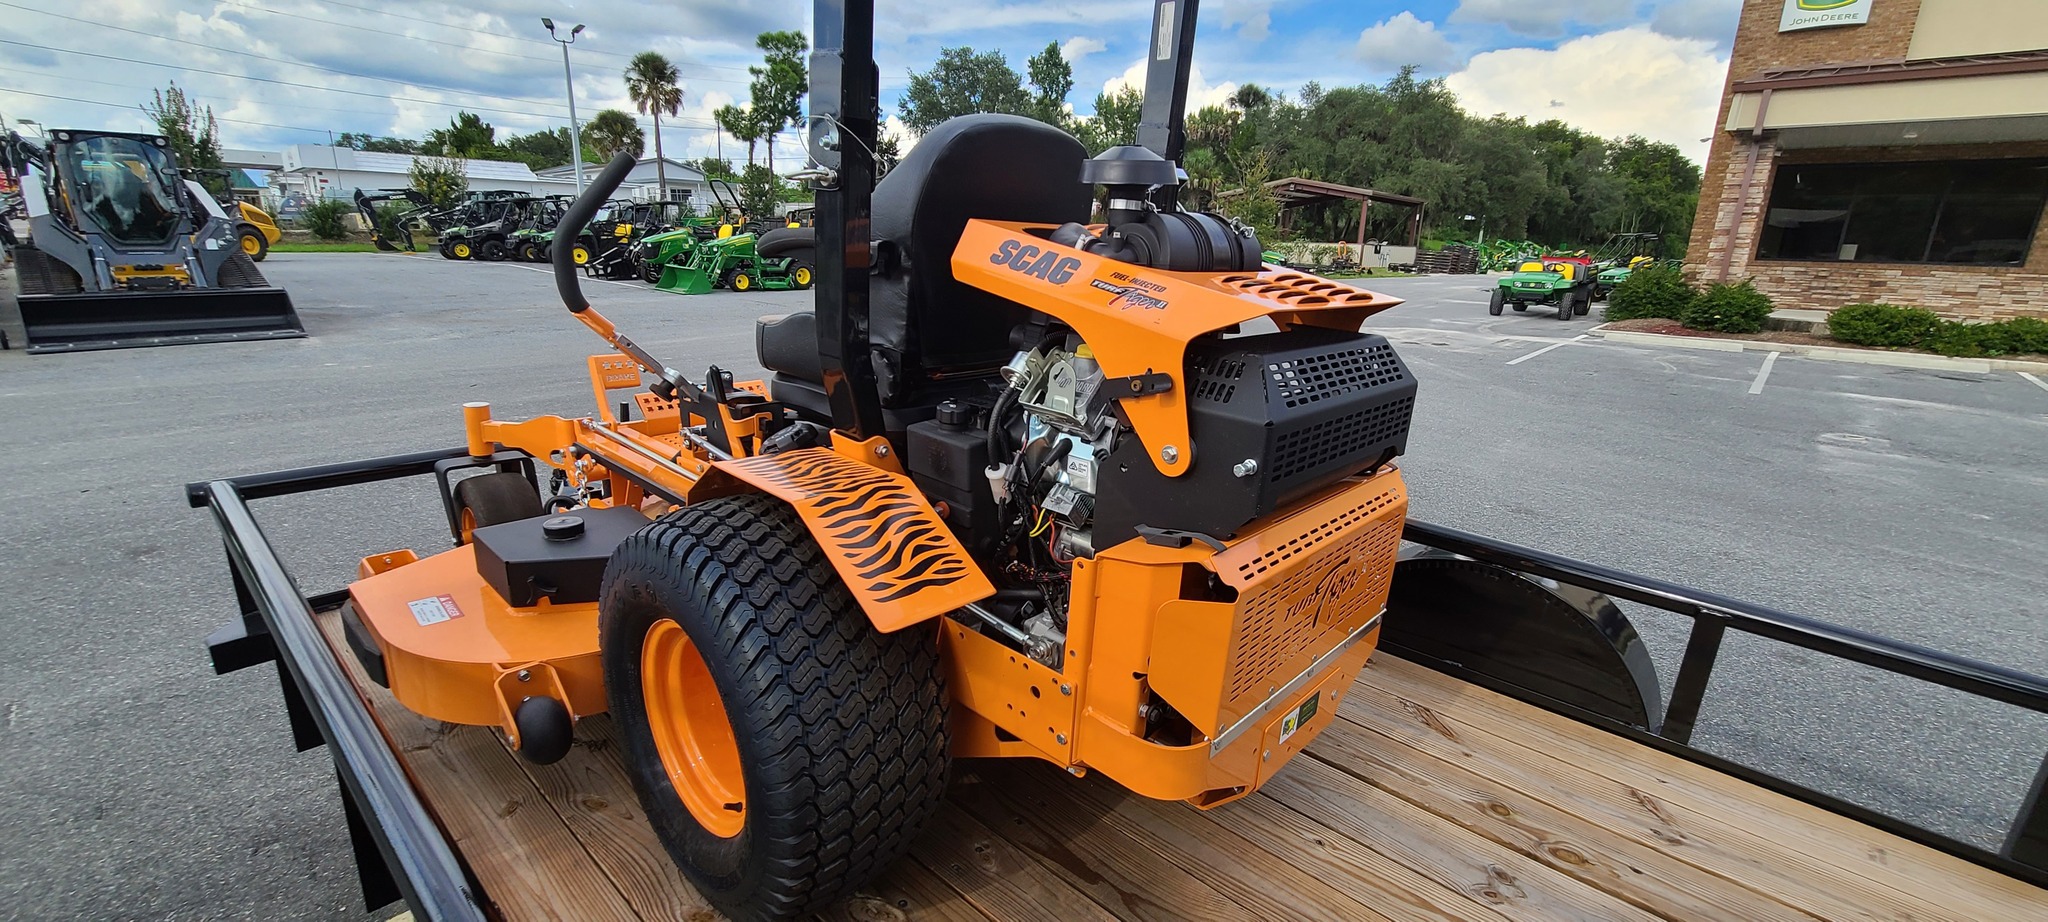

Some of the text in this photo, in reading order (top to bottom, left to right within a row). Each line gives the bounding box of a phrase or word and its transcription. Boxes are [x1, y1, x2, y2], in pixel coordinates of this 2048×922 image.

[1789, 13, 1859, 26] JOHN DEERE
[989, 239, 1082, 286] SCAG
[1091, 280, 1125, 294] TURF
[1110, 271, 1167, 293] FUEL-INJECTED
[1284, 585, 1324, 623] TURF
